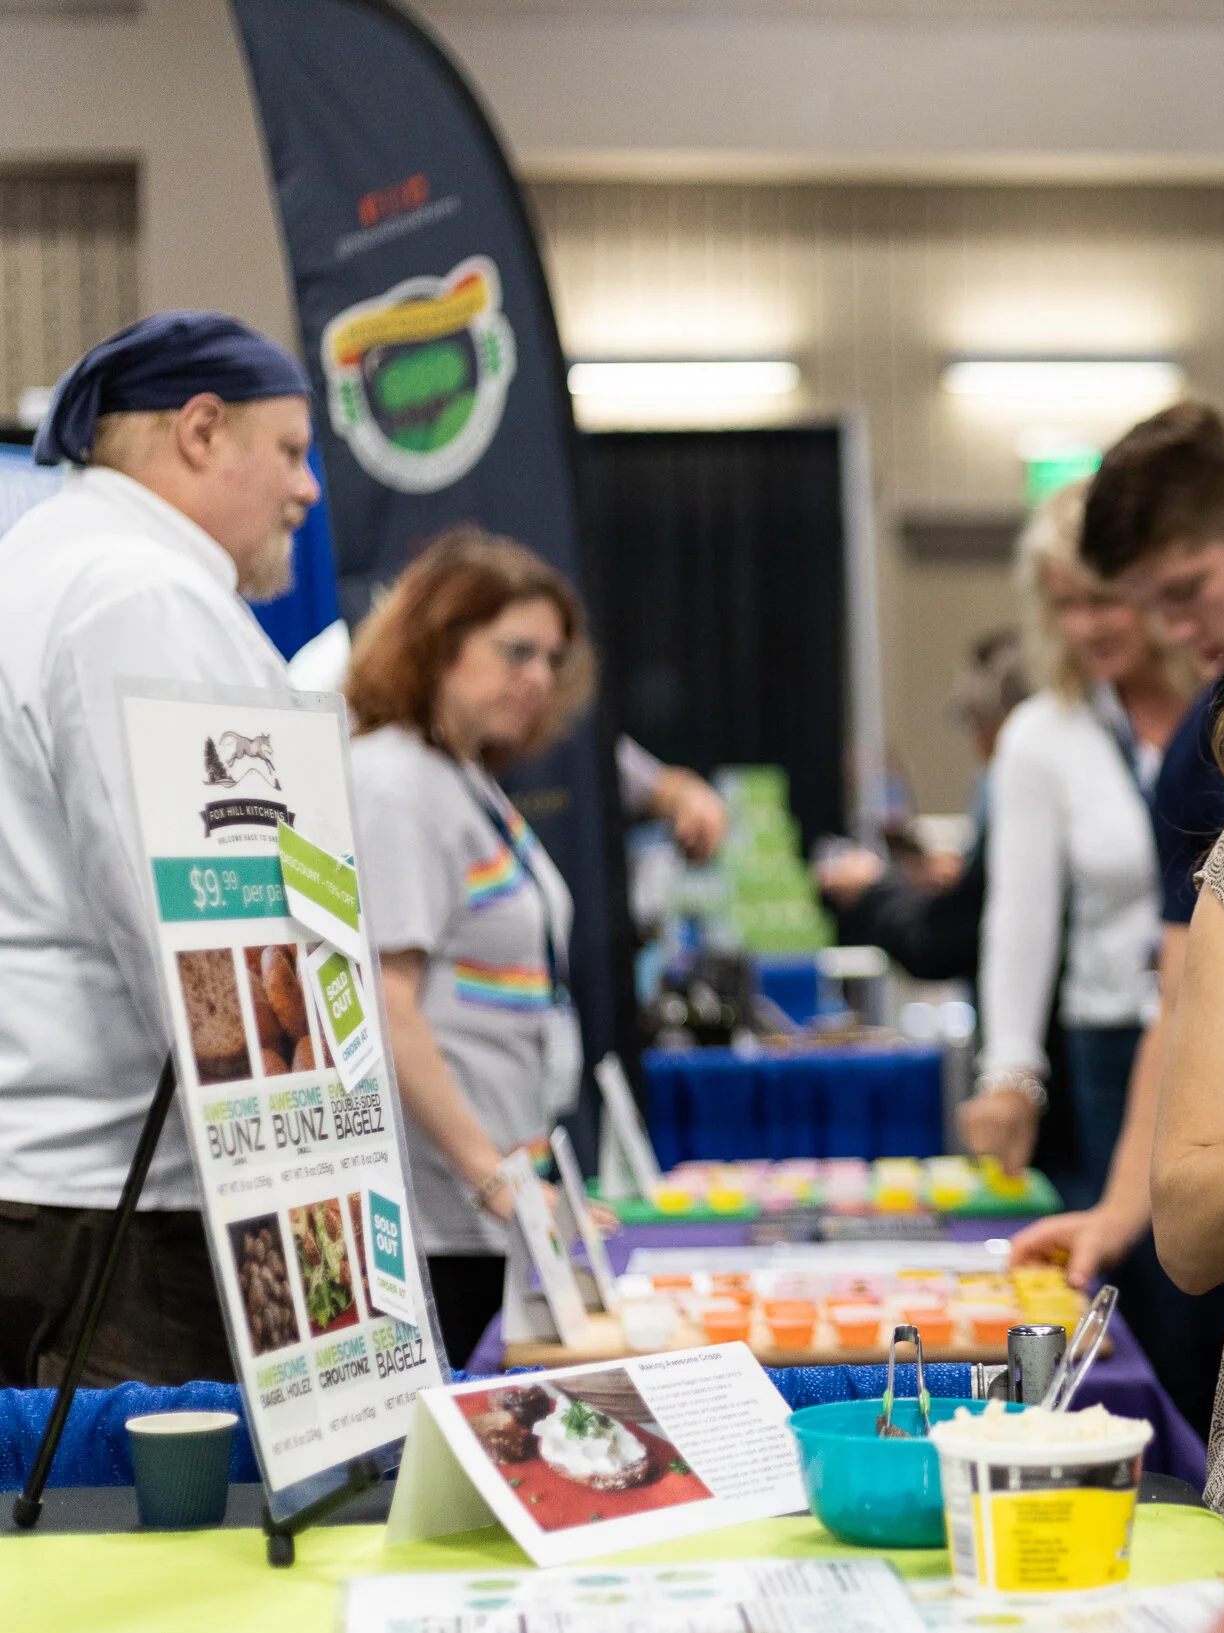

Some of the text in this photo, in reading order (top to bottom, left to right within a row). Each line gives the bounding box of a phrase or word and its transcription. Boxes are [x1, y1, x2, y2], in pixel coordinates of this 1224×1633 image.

[209, 805, 285, 821] FOX HILL KITCHENS
[242, 885, 264, 908] per
[266, 884, 285, 908] pa
[325, 971, 348, 1001] SOLD
[332, 987, 353, 1019] OUT
[342, 1035, 362, 1061] ORDER
[360, 1028, 369, 1044] AT
[203, 1096, 260, 1122] AWESOME
[268, 1086, 323, 1113] AWESOME
[330, 1093, 381, 1114] DOUBLE-SIDED
[206, 1117, 266, 1160] BUNZ
[272, 1107, 328, 1148] BUNZ
[334, 1107, 385, 1140] BAGELZ
[340, 1158, 351, 1169] NET
[374, 1214, 398, 1238] SOLD
[376, 1233, 398, 1257] OUT
[315, 1335, 366, 1368] AWESOME
[376, 1338, 427, 1379] BAGELZ
[638, 1351, 723, 1372] Making Awesome Crisps
[256, 1355, 308, 1388] AWESOME
[319, 1356, 370, 1389] CROUTONZ
[260, 1377, 312, 1409] BAGEL HOLEZ
[384, 1398, 395, 1411] NET
